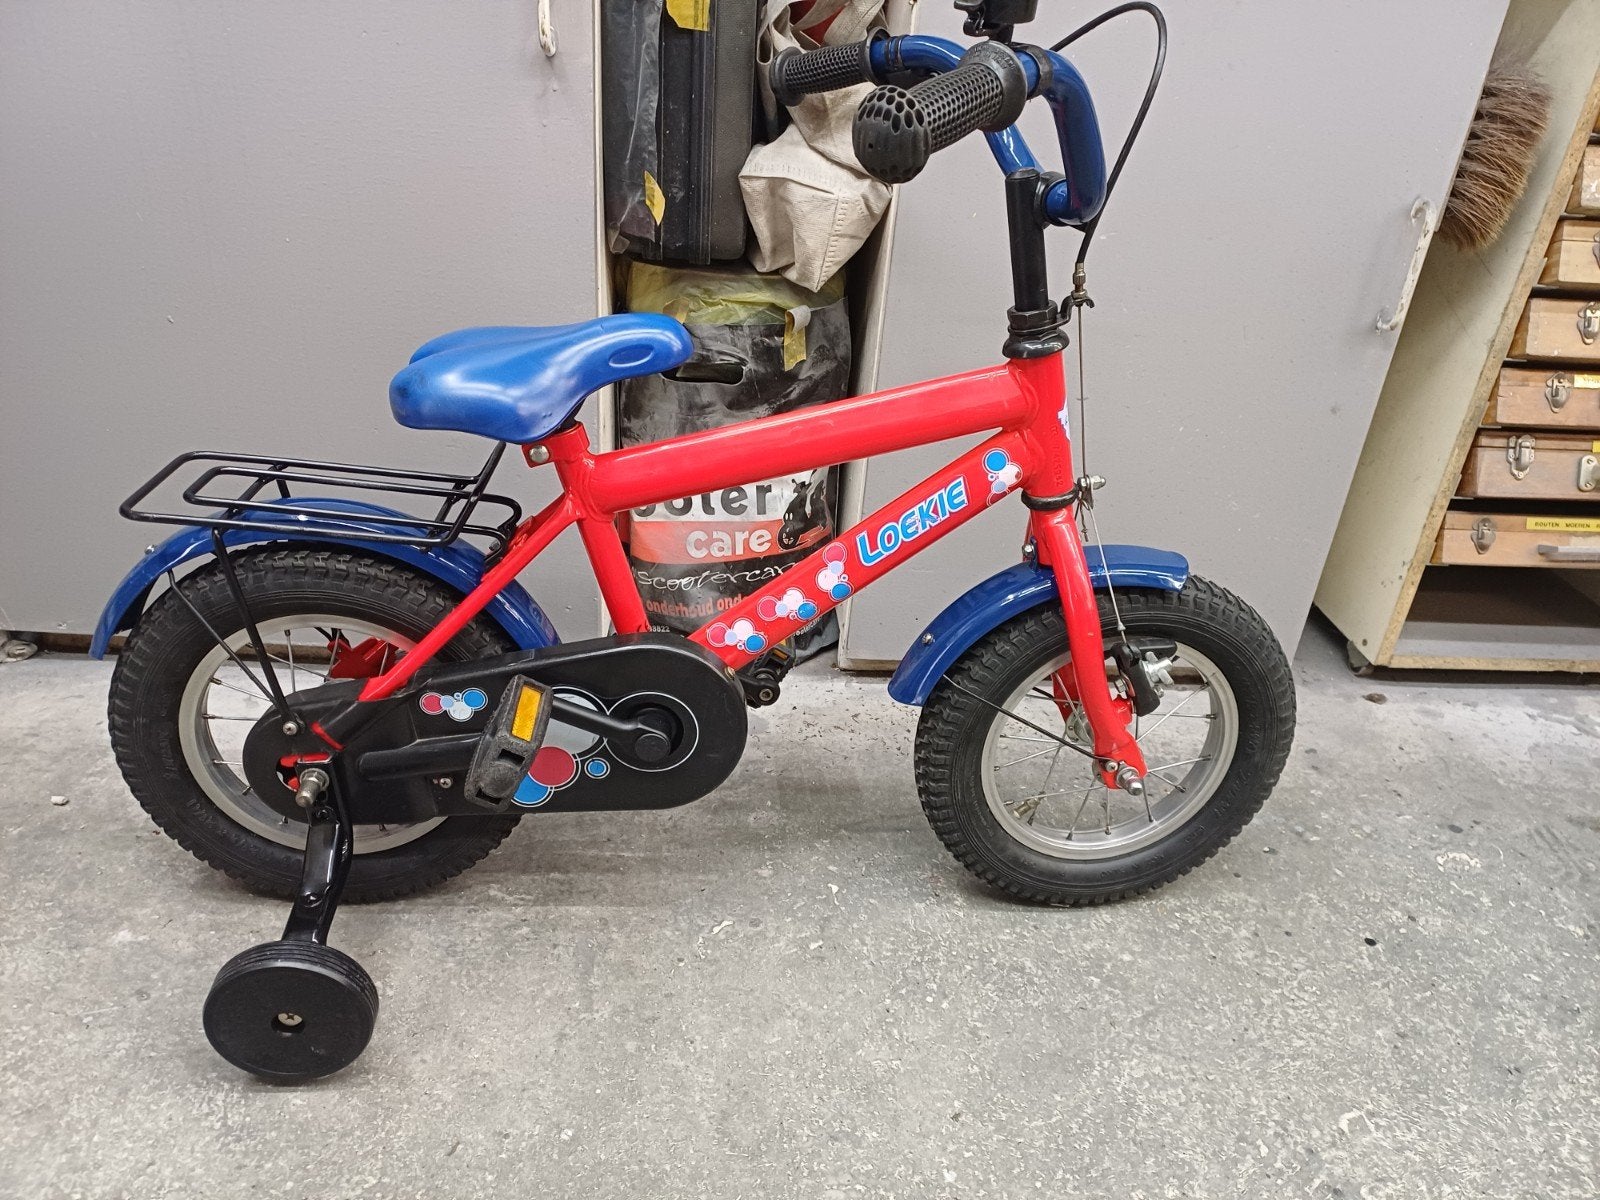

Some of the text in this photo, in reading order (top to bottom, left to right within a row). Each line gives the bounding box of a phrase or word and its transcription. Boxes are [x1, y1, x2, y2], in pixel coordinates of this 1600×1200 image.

[856, 475, 969, 567] LOEKIE
[685, 529, 772, 559] care
[646, 593, 748, 618] onderhoud ond
